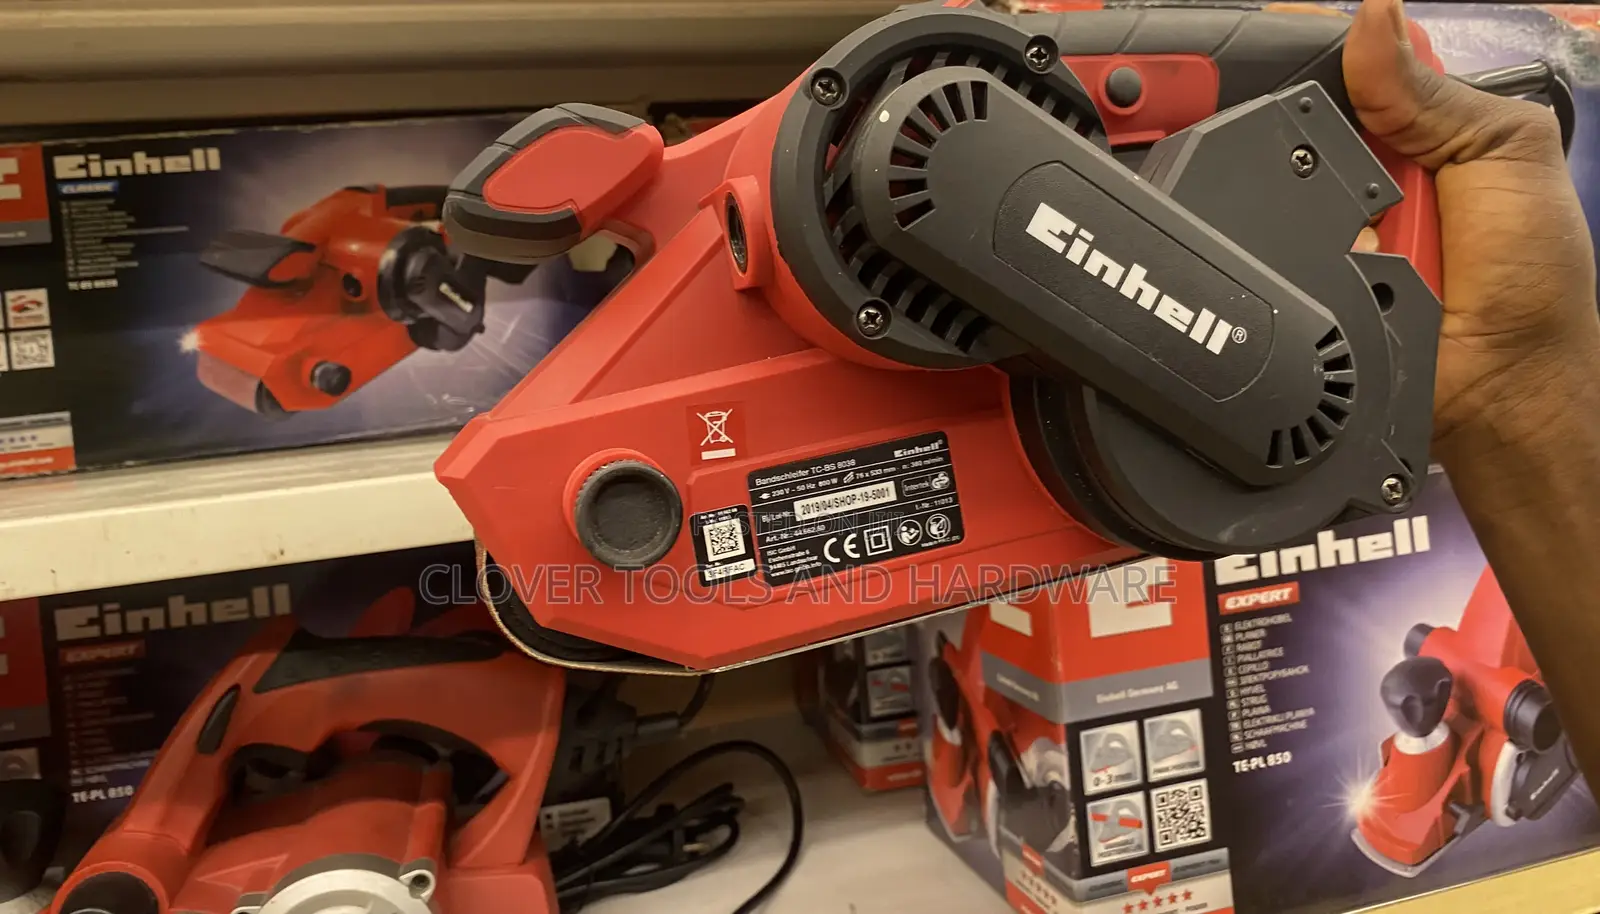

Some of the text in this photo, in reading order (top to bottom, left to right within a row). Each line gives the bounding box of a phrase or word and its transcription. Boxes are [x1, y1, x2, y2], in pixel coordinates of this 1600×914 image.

[53, 147, 221, 179] Einhell
[755, 459, 856, 486] Bandschleifer TC-BS 8038
[800, 487, 890, 515] 2019/04/SHOP-19-5001
[1214, 515, 1430, 586] Einhell
[54, 583, 292, 641] Einhell
[1225, 587, 1293, 610] EXPERT
[1232, 751, 1293, 773] TE-PL 850
